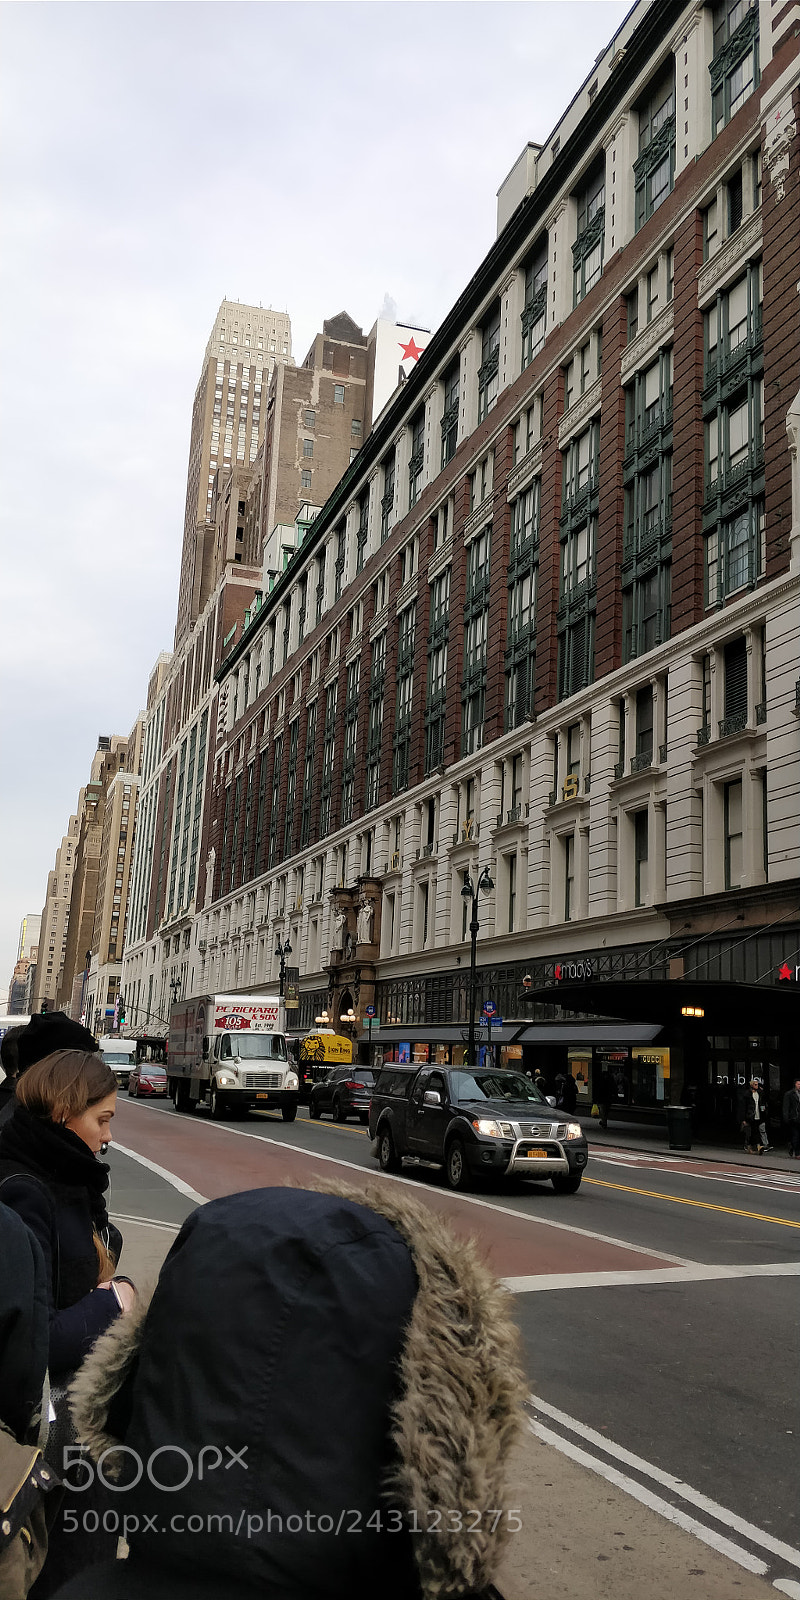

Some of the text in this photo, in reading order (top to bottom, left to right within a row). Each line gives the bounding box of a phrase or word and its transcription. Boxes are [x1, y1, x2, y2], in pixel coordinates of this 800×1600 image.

[563, 774, 578, 801] S
[232, 1006, 278, 1014] RICHARD
[225, 1016, 242, 1026] 105
[642, 1055, 663, 1064] GUCCI
